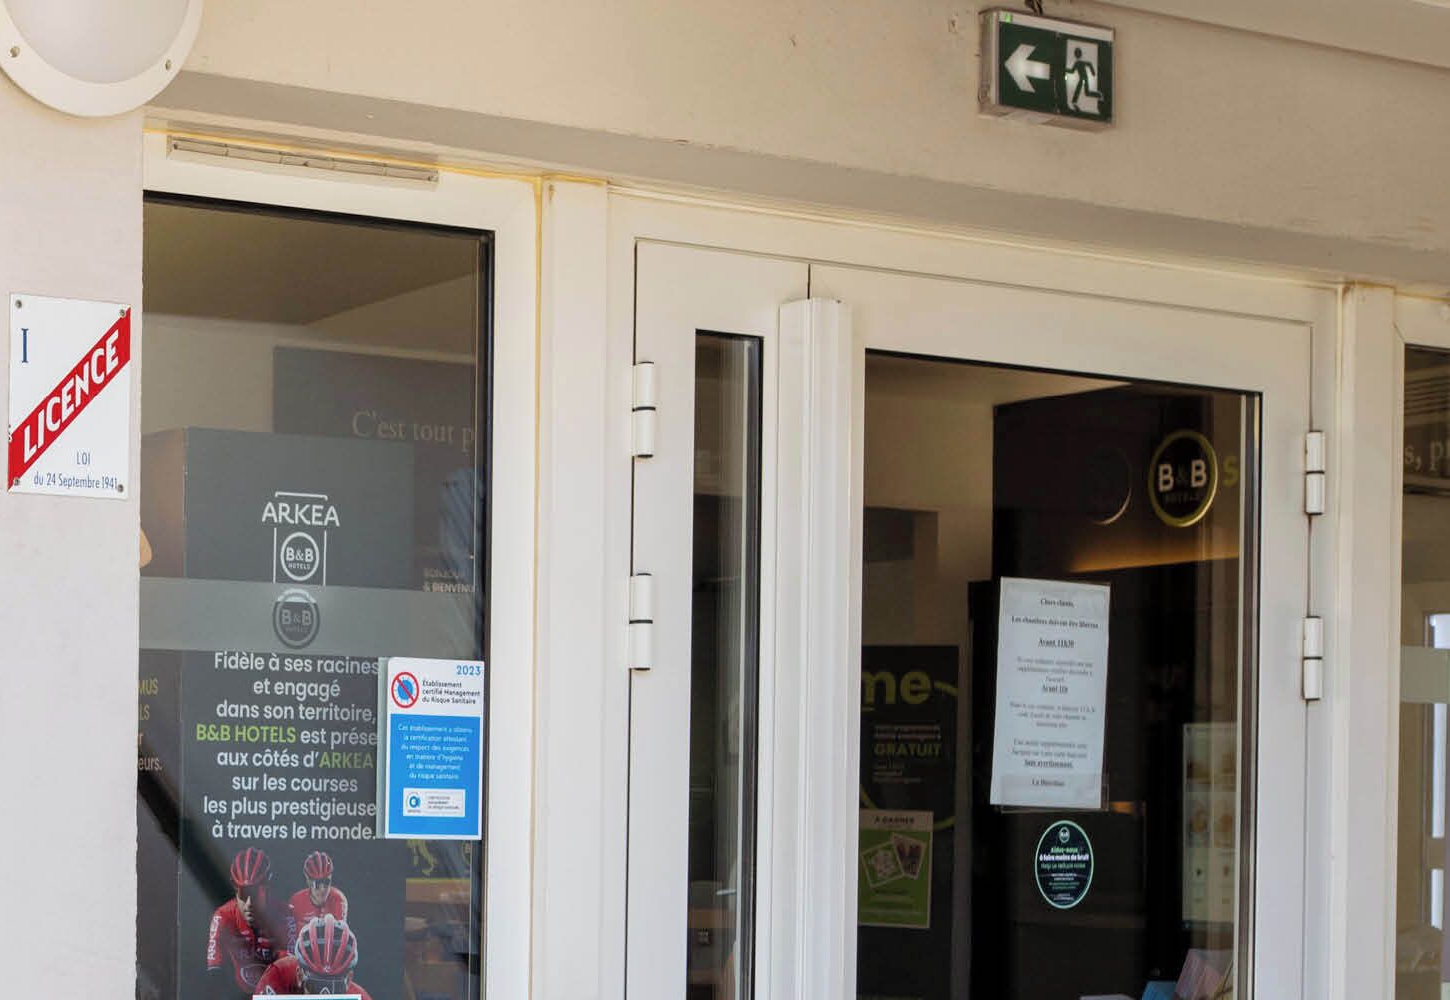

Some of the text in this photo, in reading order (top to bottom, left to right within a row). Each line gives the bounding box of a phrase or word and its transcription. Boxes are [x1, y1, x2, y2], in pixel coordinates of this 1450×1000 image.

[21, 328, 29, 363] I
[24, 329, 119, 463] LICENCE
[353, 410, 407, 439] C'est
[413, 422, 454, 441] tout
[77, 452, 90, 465] LOI
[34, 472, 117, 489] du 24 Septembre 1941
[1158, 460, 1206, 492] B&B
[262, 502, 340, 527] ARKEA
[286, 547, 313, 562] B&B
[214, 652, 378, 675] Fidèle à ses racines
[456, 665, 481, 675] 2023
[422, 688, 480, 698] certifié Management
[431, 696, 450, 705] Risque
[197, 724, 230, 741] B&B
[235, 724, 295, 743] HOTELS
[301, 730, 326, 744] est
[217, 752, 248, 767] aux
[252, 749, 298, 768] côtés
[212, 822, 376, 840] à travers le monde.
